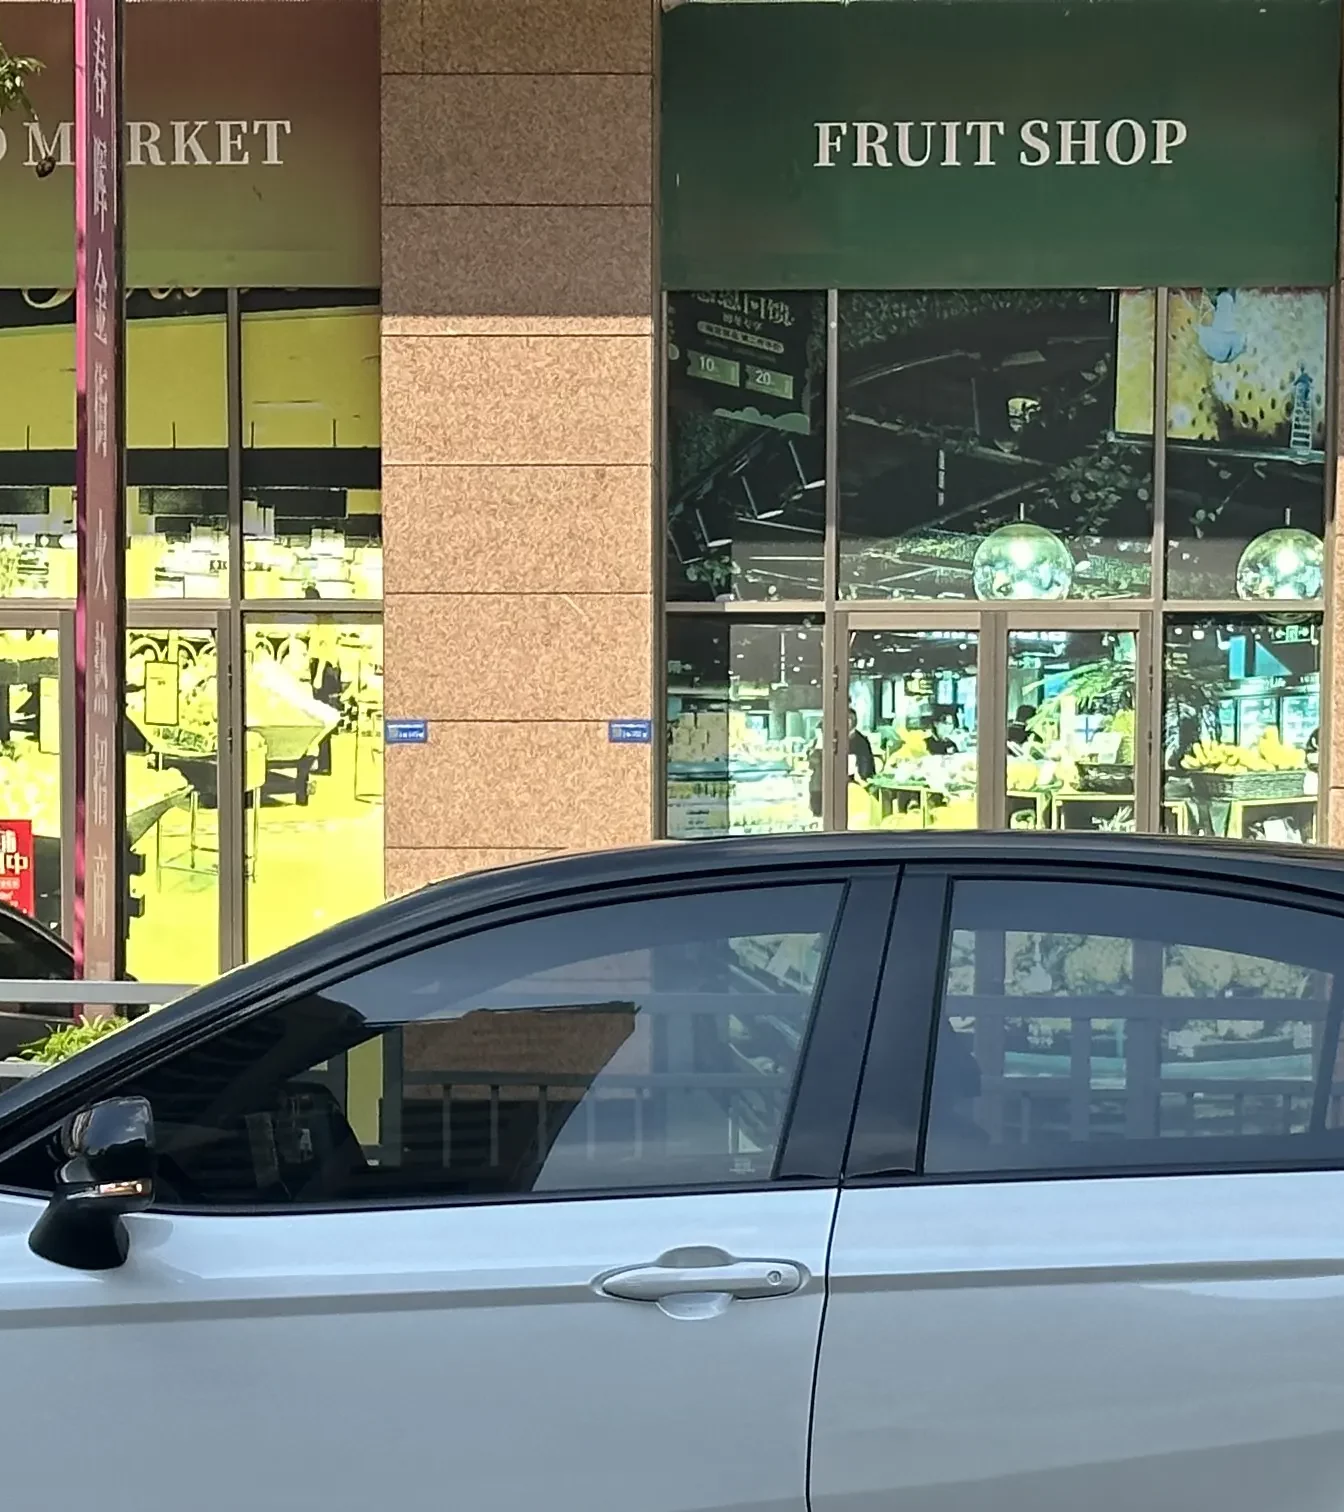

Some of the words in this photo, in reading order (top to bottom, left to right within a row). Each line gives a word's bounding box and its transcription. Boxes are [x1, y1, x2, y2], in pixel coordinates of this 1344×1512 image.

[22, 119, 291, 167] MRKET
[813, 119, 1004, 167] FRUIT
[1019, 119, 1188, 167] SHOP
[755, 369, 771, 386] 20
